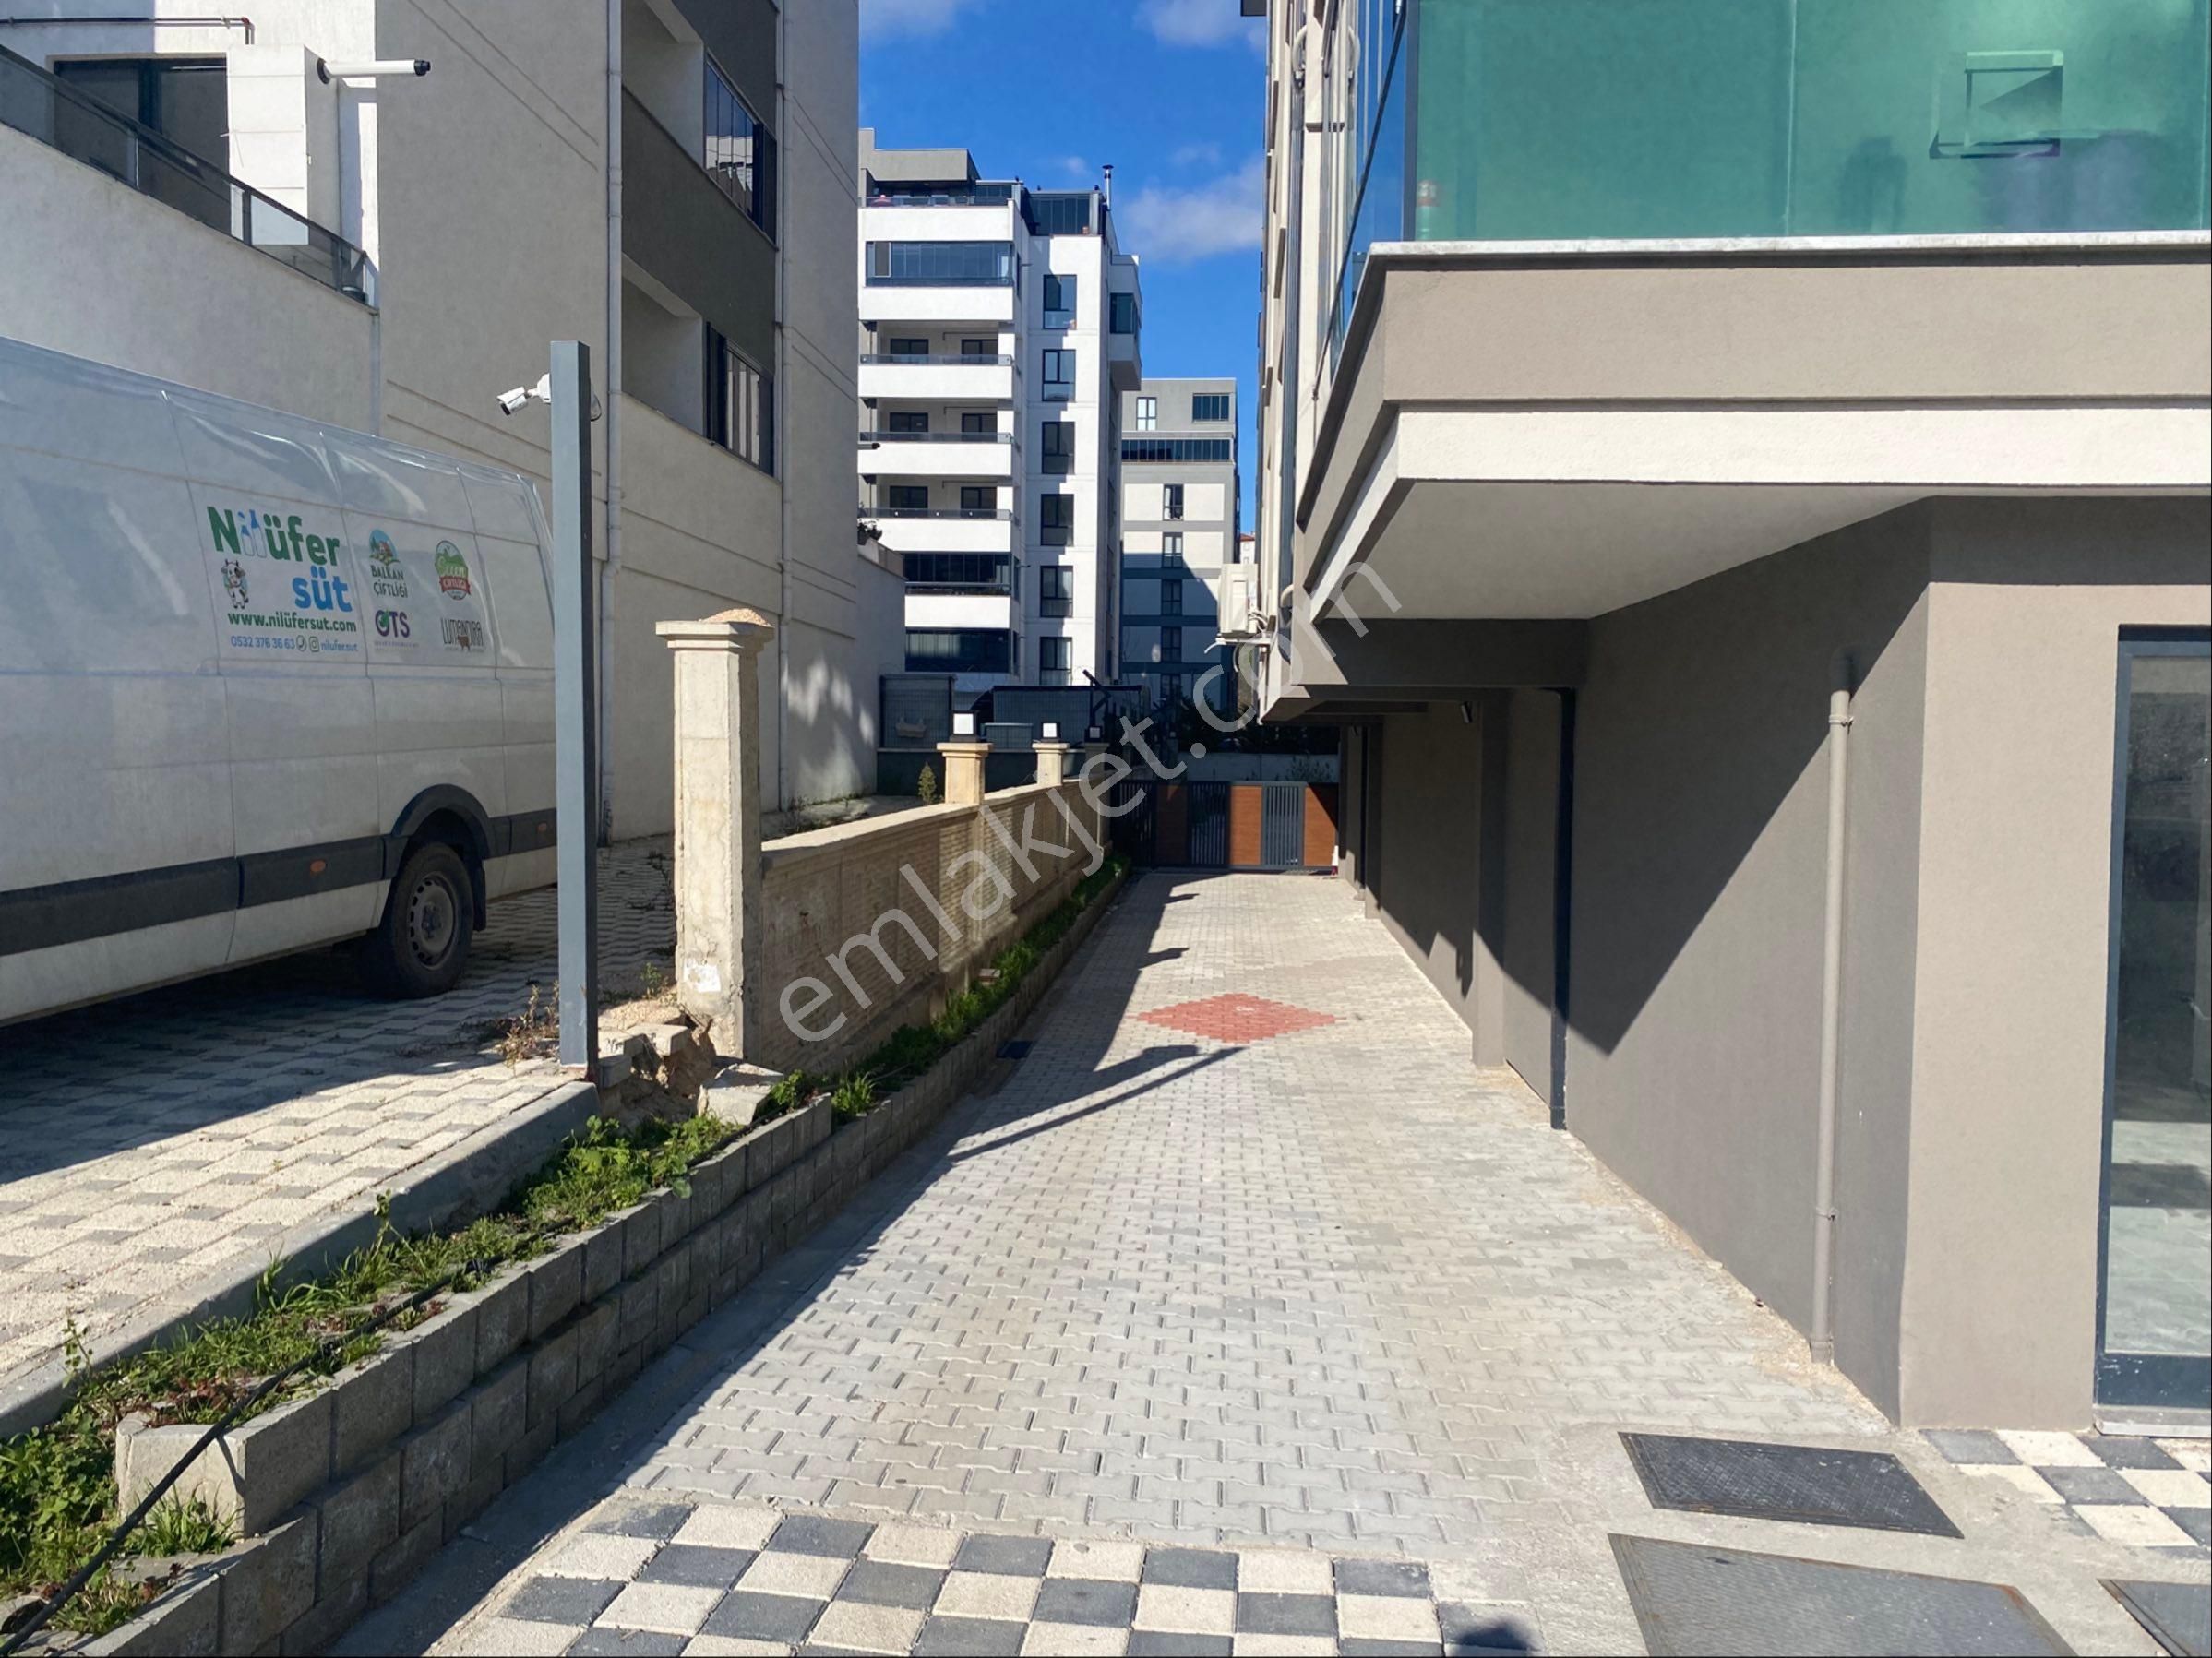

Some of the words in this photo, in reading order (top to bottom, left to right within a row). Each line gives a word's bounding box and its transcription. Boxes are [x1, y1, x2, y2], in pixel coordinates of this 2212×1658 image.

[207, 507, 340, 566] Nilüfer
[370, 565, 404, 580] BALKAN
[293, 566, 353, 613] süt
[231, 635, 253, 647] 0532
[255, 637, 270, 648] 376
